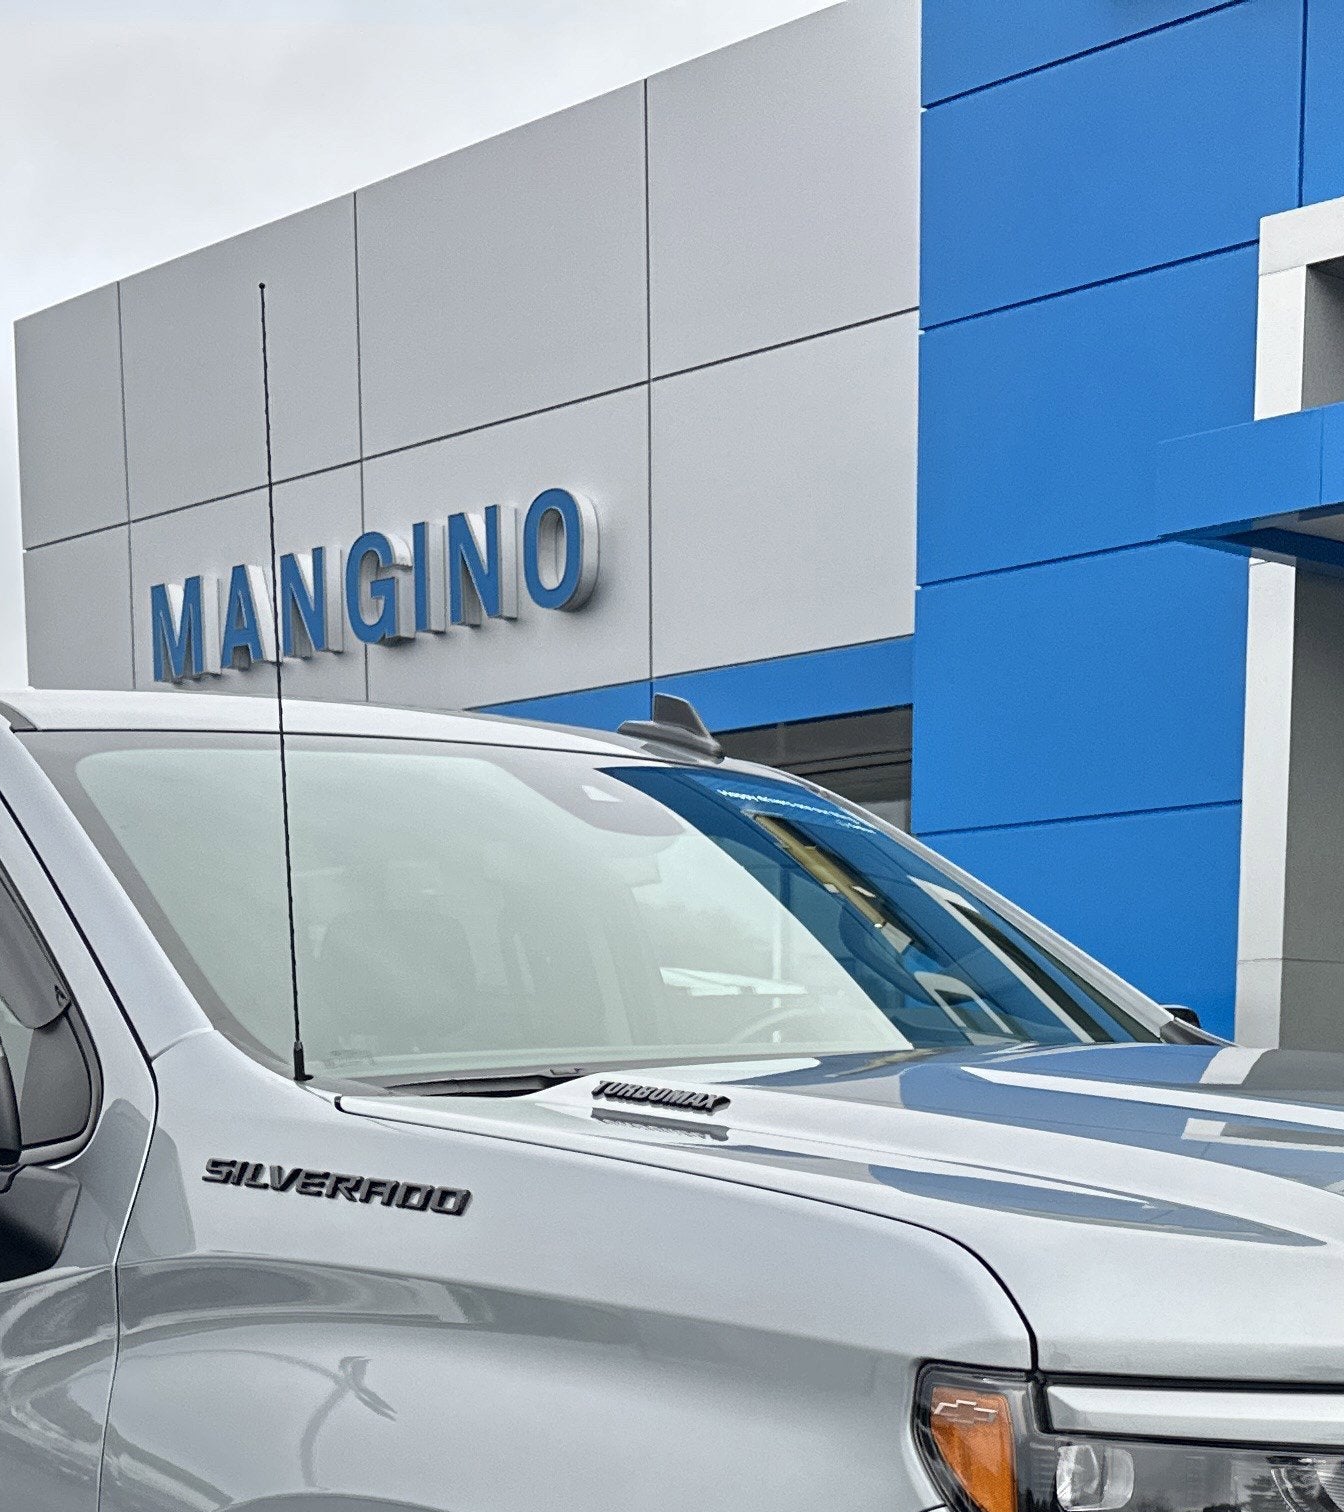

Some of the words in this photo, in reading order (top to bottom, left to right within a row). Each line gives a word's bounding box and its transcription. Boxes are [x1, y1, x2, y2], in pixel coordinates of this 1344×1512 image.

[151, 487, 600, 683] MANGINO
[591, 1080, 731, 1113] TURBOMAX
[202, 1157, 472, 1217] SILVERADO
